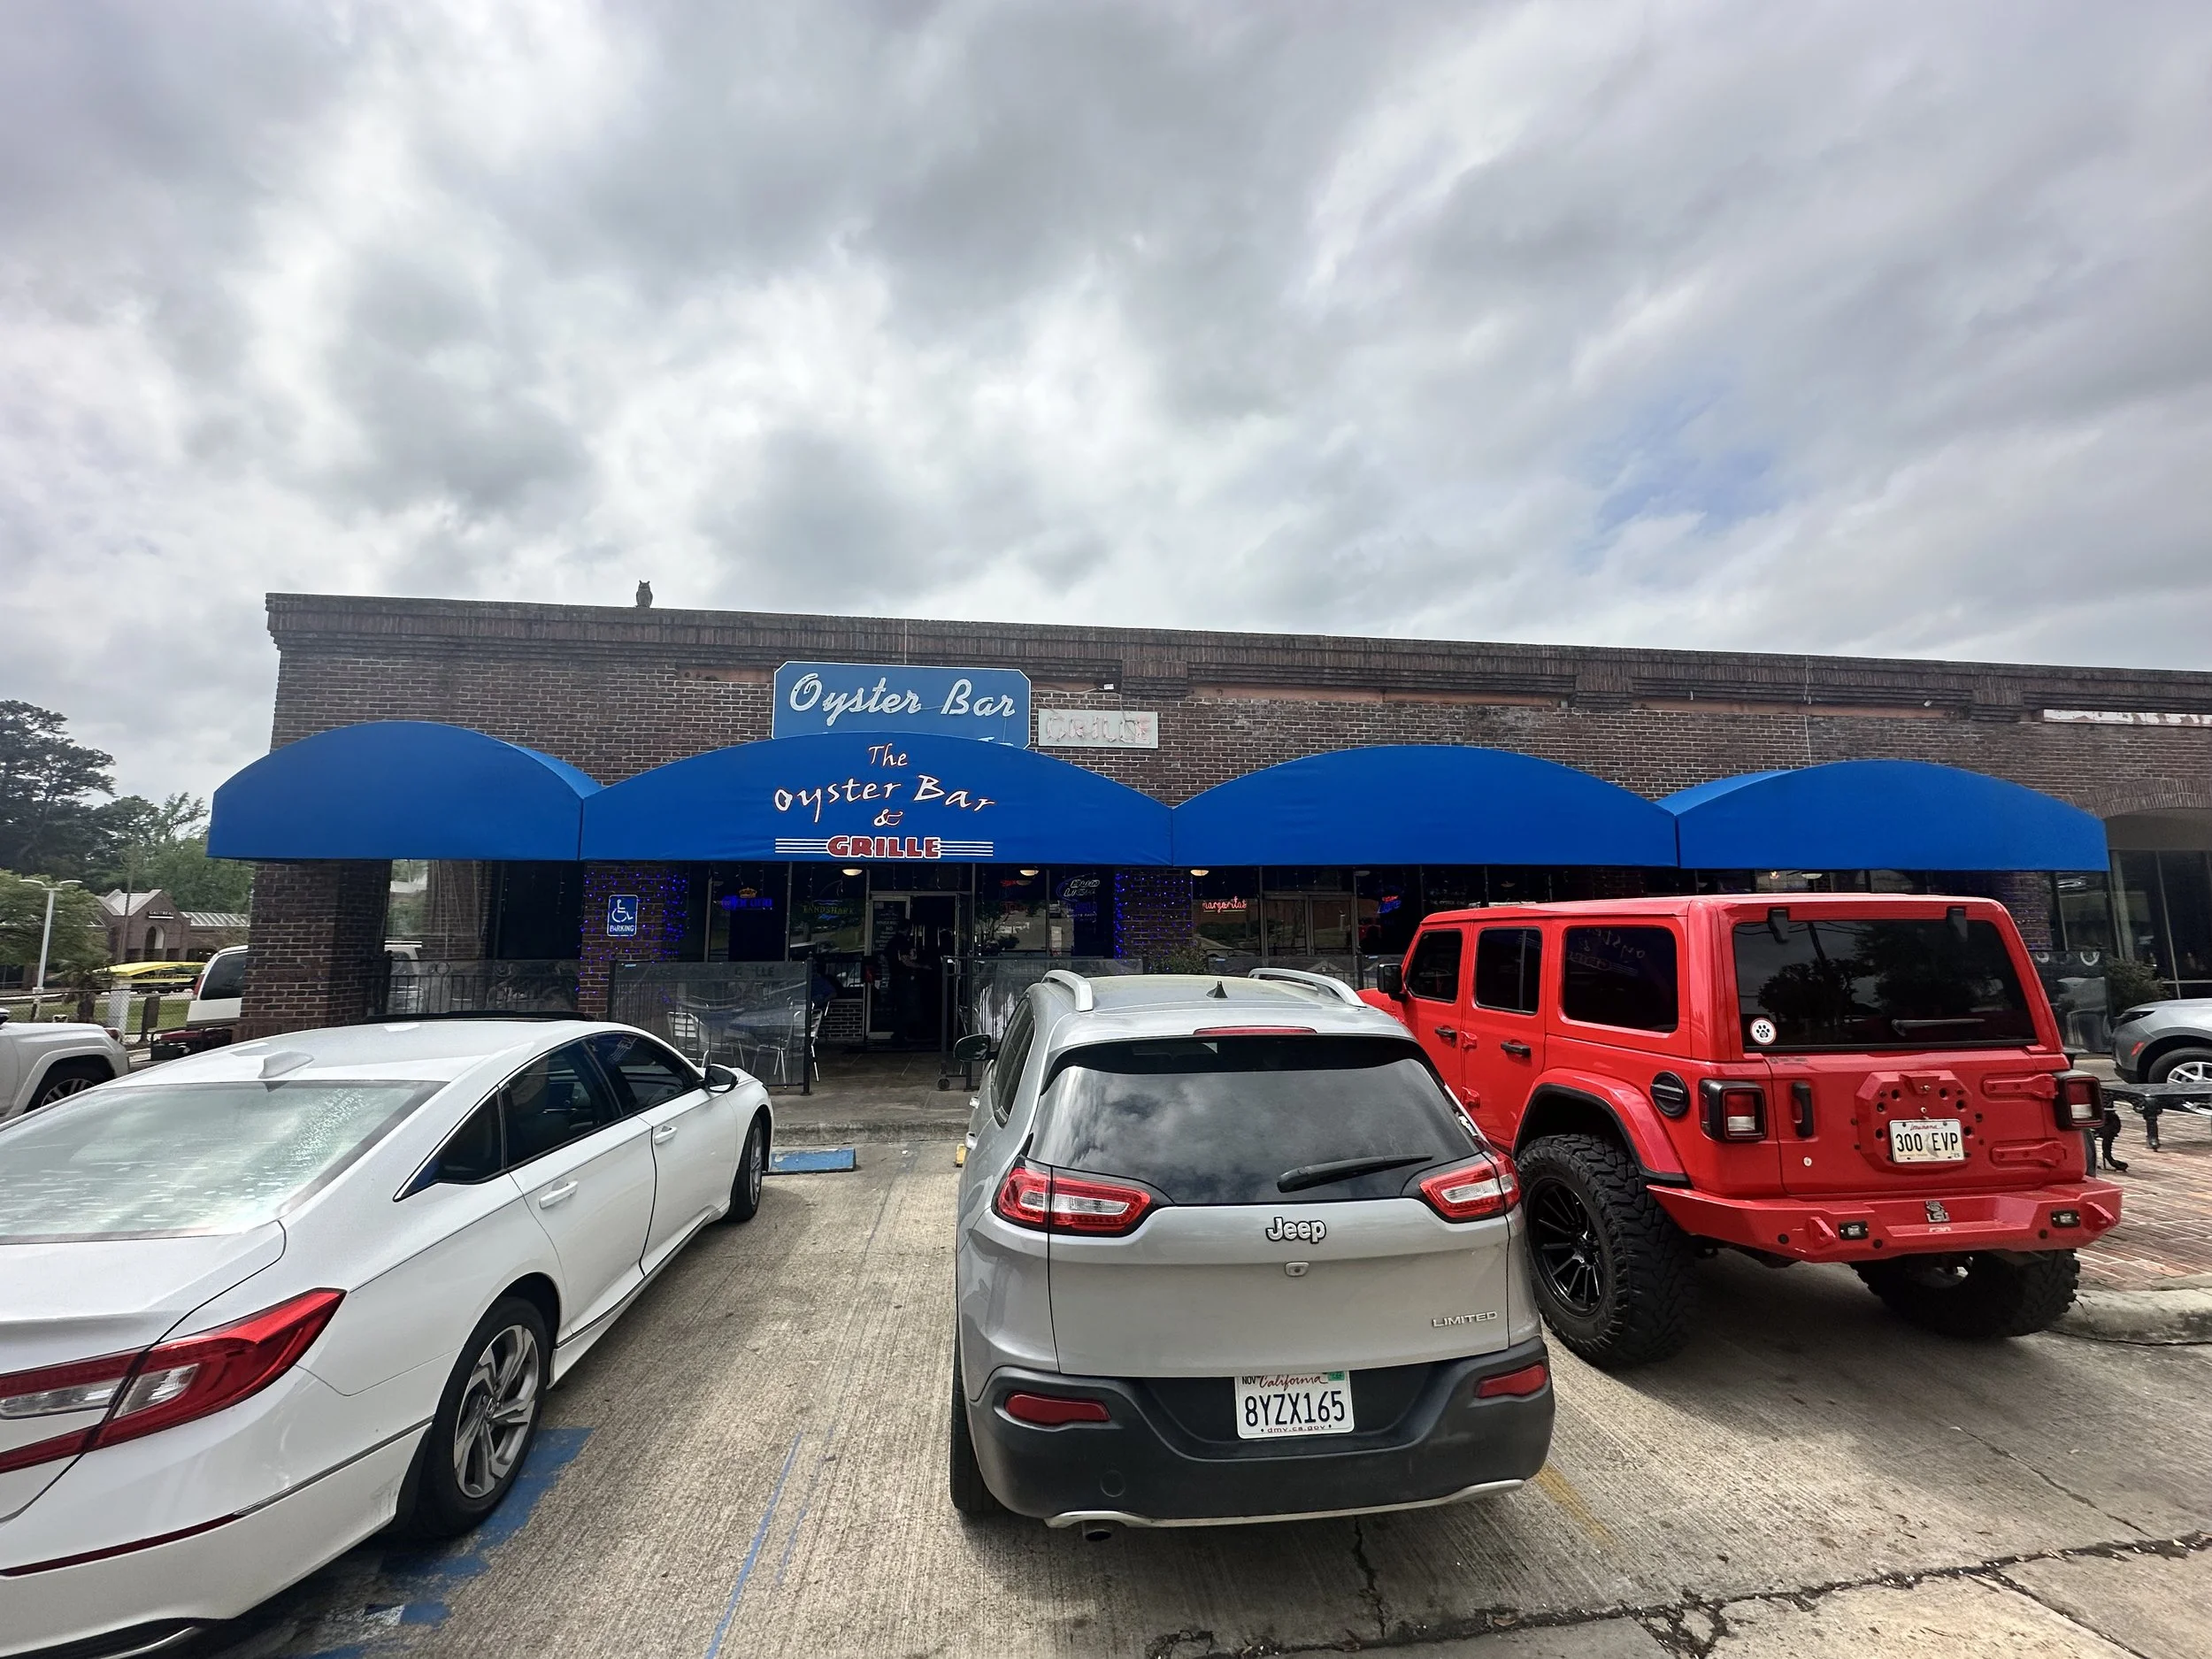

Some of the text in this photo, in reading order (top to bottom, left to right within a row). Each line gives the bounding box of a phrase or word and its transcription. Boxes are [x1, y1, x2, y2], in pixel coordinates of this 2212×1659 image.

[789, 672, 1016, 726] Oyster Bar
[868, 742, 908, 767] The
[913, 774, 995, 812] Bar
[873, 809, 903, 827] &
[826, 835, 941, 858] GRILLE
[1895, 1133, 1958, 1152] 300 EVP
[1265, 1217, 1326, 1243] Jeep
[1432, 1310, 1498, 1328] LIMITED
[1241, 1375, 1256, 1386] NOV
[1257, 1374, 1328, 1392] California
[1244, 1390, 1345, 1427] 8YZX165
[1267, 1425, 1325, 1433] dmv.ca.gov
